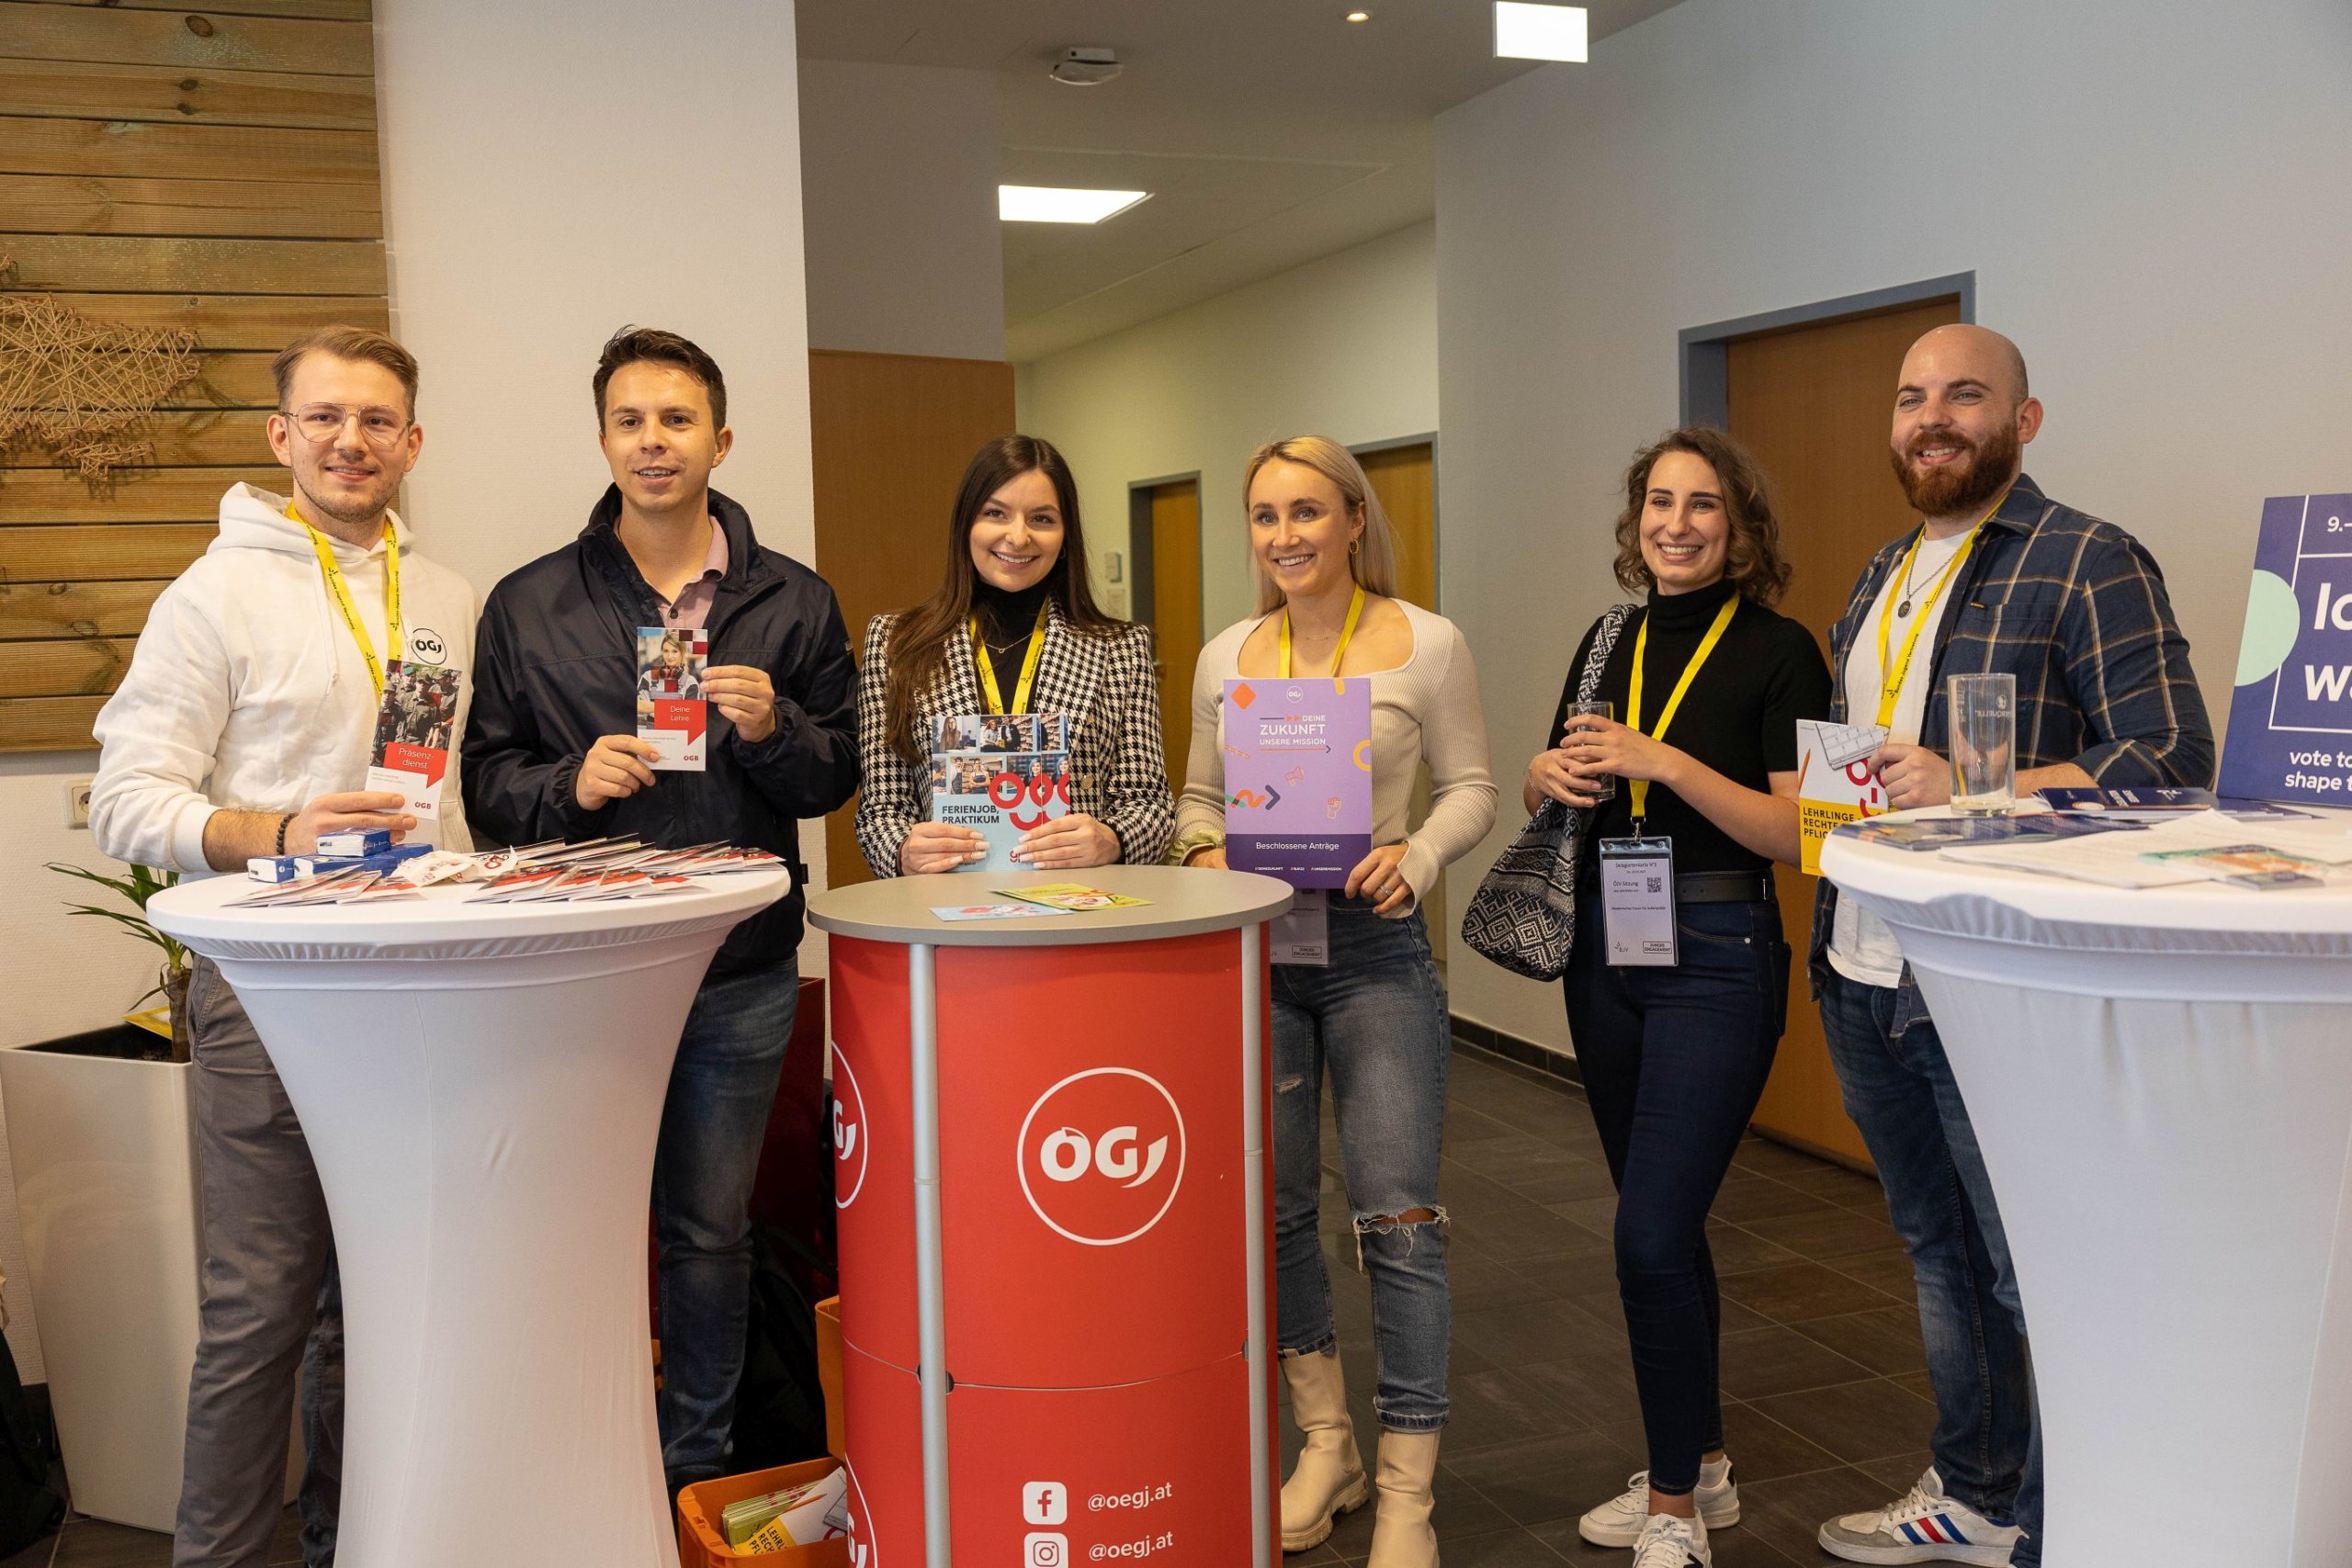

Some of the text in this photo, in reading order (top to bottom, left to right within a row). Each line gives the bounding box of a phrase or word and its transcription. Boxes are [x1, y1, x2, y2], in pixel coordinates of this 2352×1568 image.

[1902, 658, 1910, 678] Jugend
[1259, 724, 1327, 736] ZUKUNFT
[1259, 738, 1327, 746] UNSERE MISSION
[398, 747, 435, 760] Präsenz-
[2290, 750, 2333, 767] vote
[401, 759, 428, 770] dienst
[2284, 771, 2343, 794] shape
[942, 805, 1000, 815] FERIENJOB,
[1803, 807, 1854, 822] LEHRLINGE
[942, 815, 1000, 825] PRAKTIKUM
[1255, 841, 1340, 852] Beschlossene Anträge
[1087, 1481, 1173, 1512] @oegj.at
[765, 1526, 786, 1551] LEHRL
[749, 1540, 764, 1554] PFL
[1088, 1530, 1173, 1562] @oegj.at
